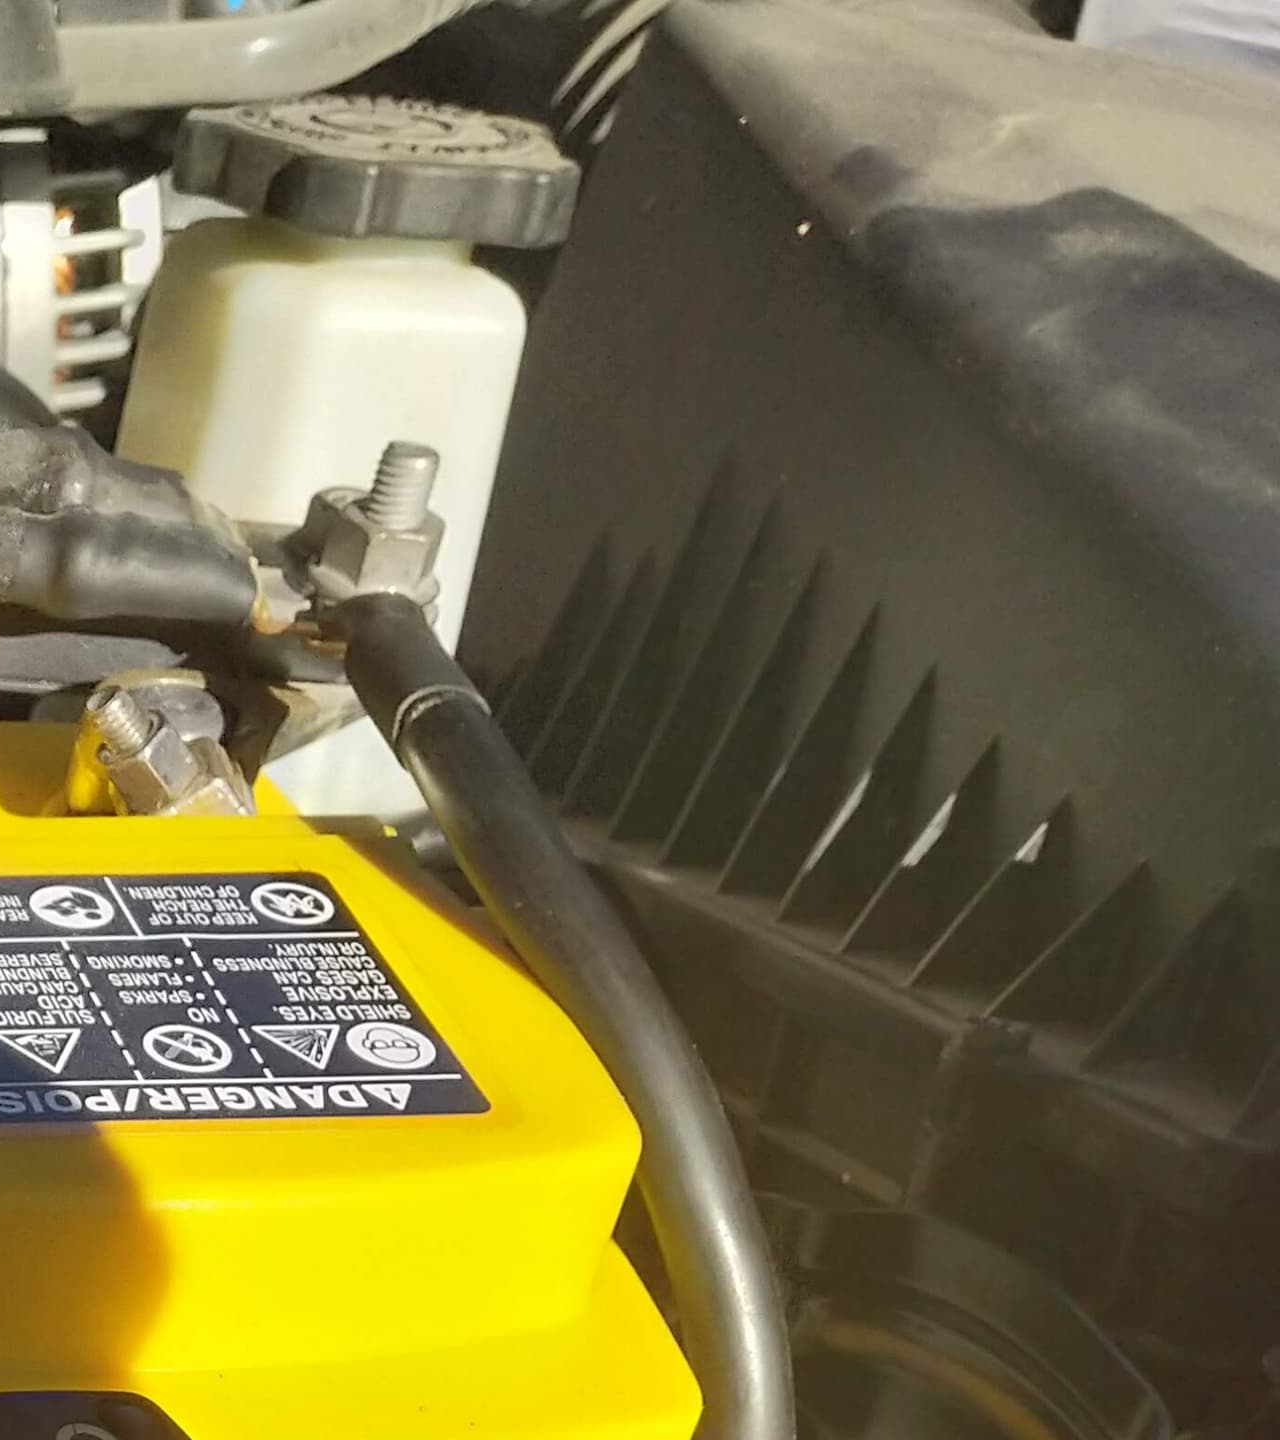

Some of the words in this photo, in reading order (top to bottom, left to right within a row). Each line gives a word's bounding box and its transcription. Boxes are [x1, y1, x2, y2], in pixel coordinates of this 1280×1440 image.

[122, 885, 214, 900] CHILDREN.
[214, 884, 240, 899] OF
[152, 899, 211, 913] REACH
[212, 898, 250, 912] THE
[148, 913, 173, 926] OF
[175, 912, 206, 926] OUT
[207, 911, 258, 925] KEEP
[268, 942, 332, 956] INJURY.
[333, 941, 365, 955] OR
[86, 954, 170, 970] SMOKING
[212, 956, 313, 972] BLINDNESS
[314, 955, 375, 970] CAUSE
[107, 972, 181, 987] FLAMES
[272, 970, 312, 985] CAN
[315, 969, 386, 985] GASES
[35, 981, 77, 995] CAN
[282, 984, 398, 1002] EXPLOSIVE
[37, 994, 85, 1009] ACID
[118, 989, 191, 1004] SPARKS
[187, 1006, 220, 1023] NO
[273, 1004, 332, 1022] EYES.
[336, 1003, 411, 1021] SHIELD
